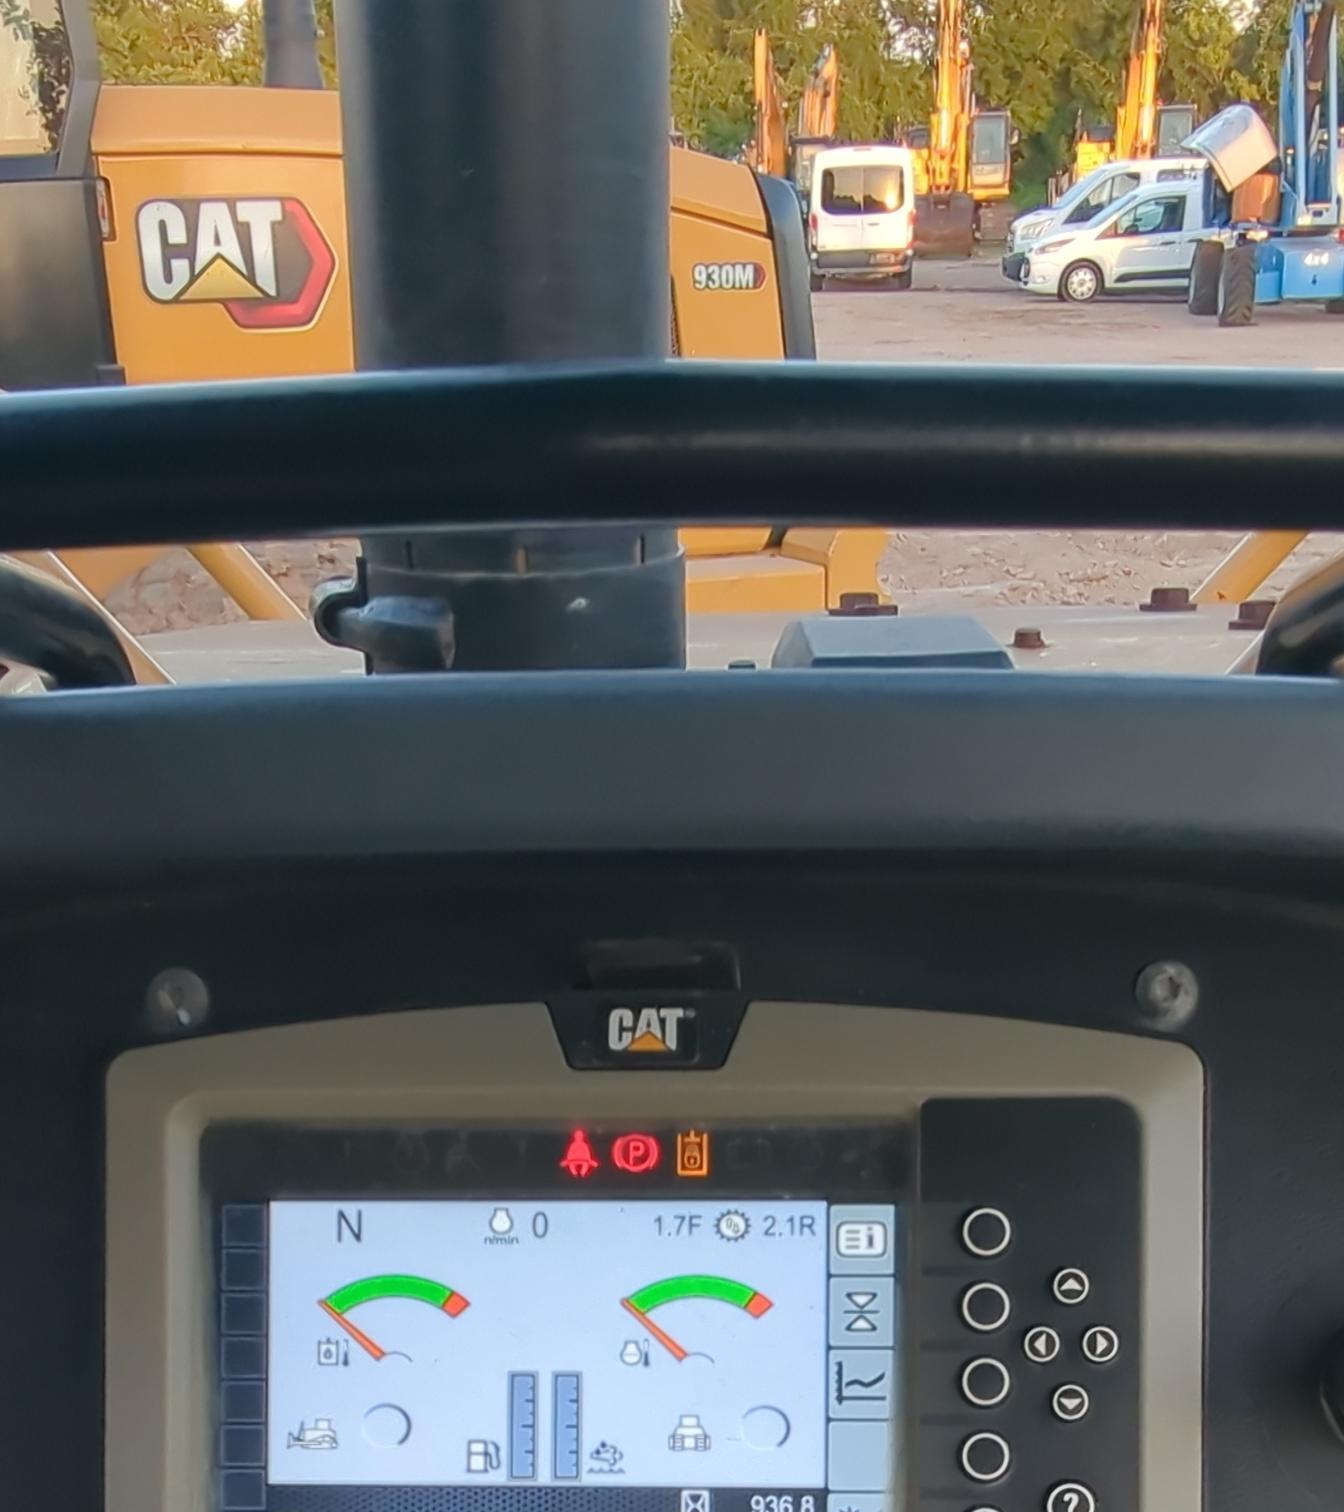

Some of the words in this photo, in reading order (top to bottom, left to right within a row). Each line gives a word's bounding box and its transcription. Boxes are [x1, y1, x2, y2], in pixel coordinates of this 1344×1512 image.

[138, 200, 282, 300] CAT
[694, 263, 754, 289] 930M
[608, 1007, 684, 1051] CAT
[337, 1209, 362, 1243] N
[532, 1211, 549, 1239] 0
[654, 1215, 702, 1237] 1.7F
[763, 1215, 816, 1237] 2.1R
